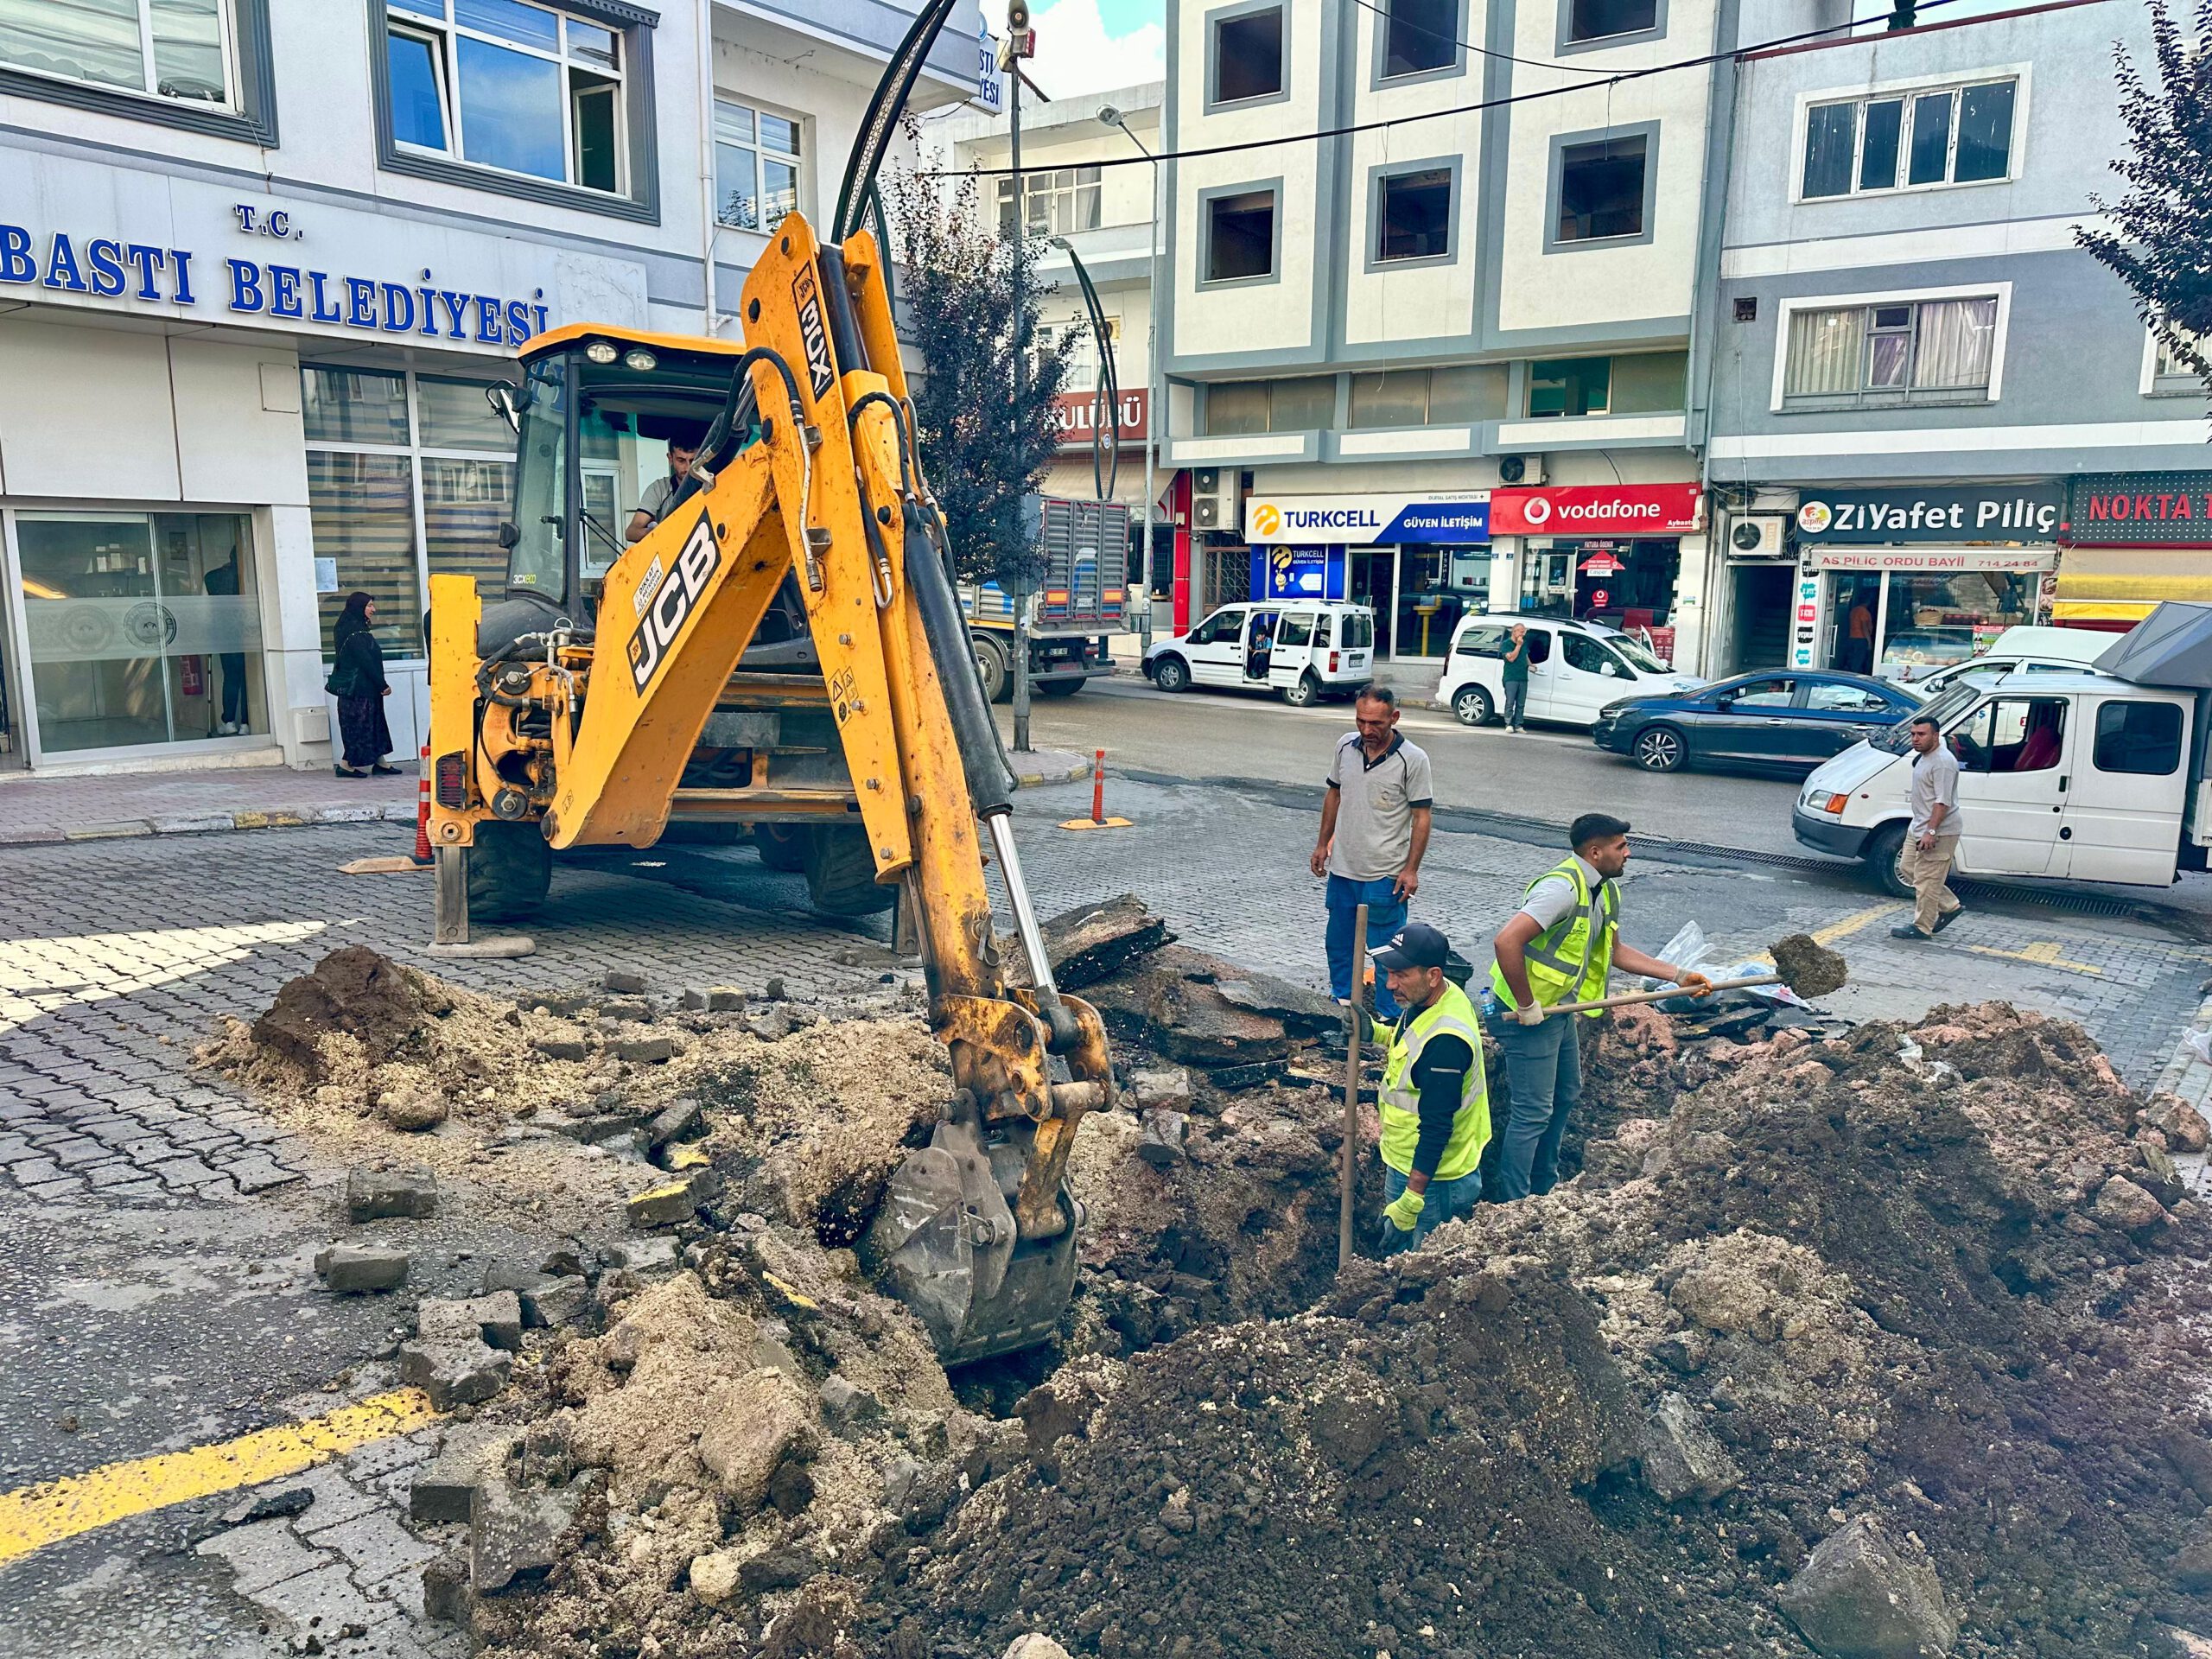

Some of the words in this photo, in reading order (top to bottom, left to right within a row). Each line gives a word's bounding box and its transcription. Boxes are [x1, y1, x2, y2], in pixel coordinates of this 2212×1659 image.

[234, 203, 304, 239] T.C.
[226, 257, 550, 347] BELEDİYESİ
[1557, 499, 1661, 519] vodafone
[2089, 493, 2192, 520] NOKTA
[1284, 510, 1381, 528] TURKCELL
[1403, 517, 1439, 529] GÜVEN
[1440, 516, 1483, 530] İLETİŞİM
[1293, 550, 1325, 558] TURKCELL
[1821, 556, 1840, 566] AS
[1883, 556, 1923, 567] ORDU
[635, 521, 716, 685] JCB
